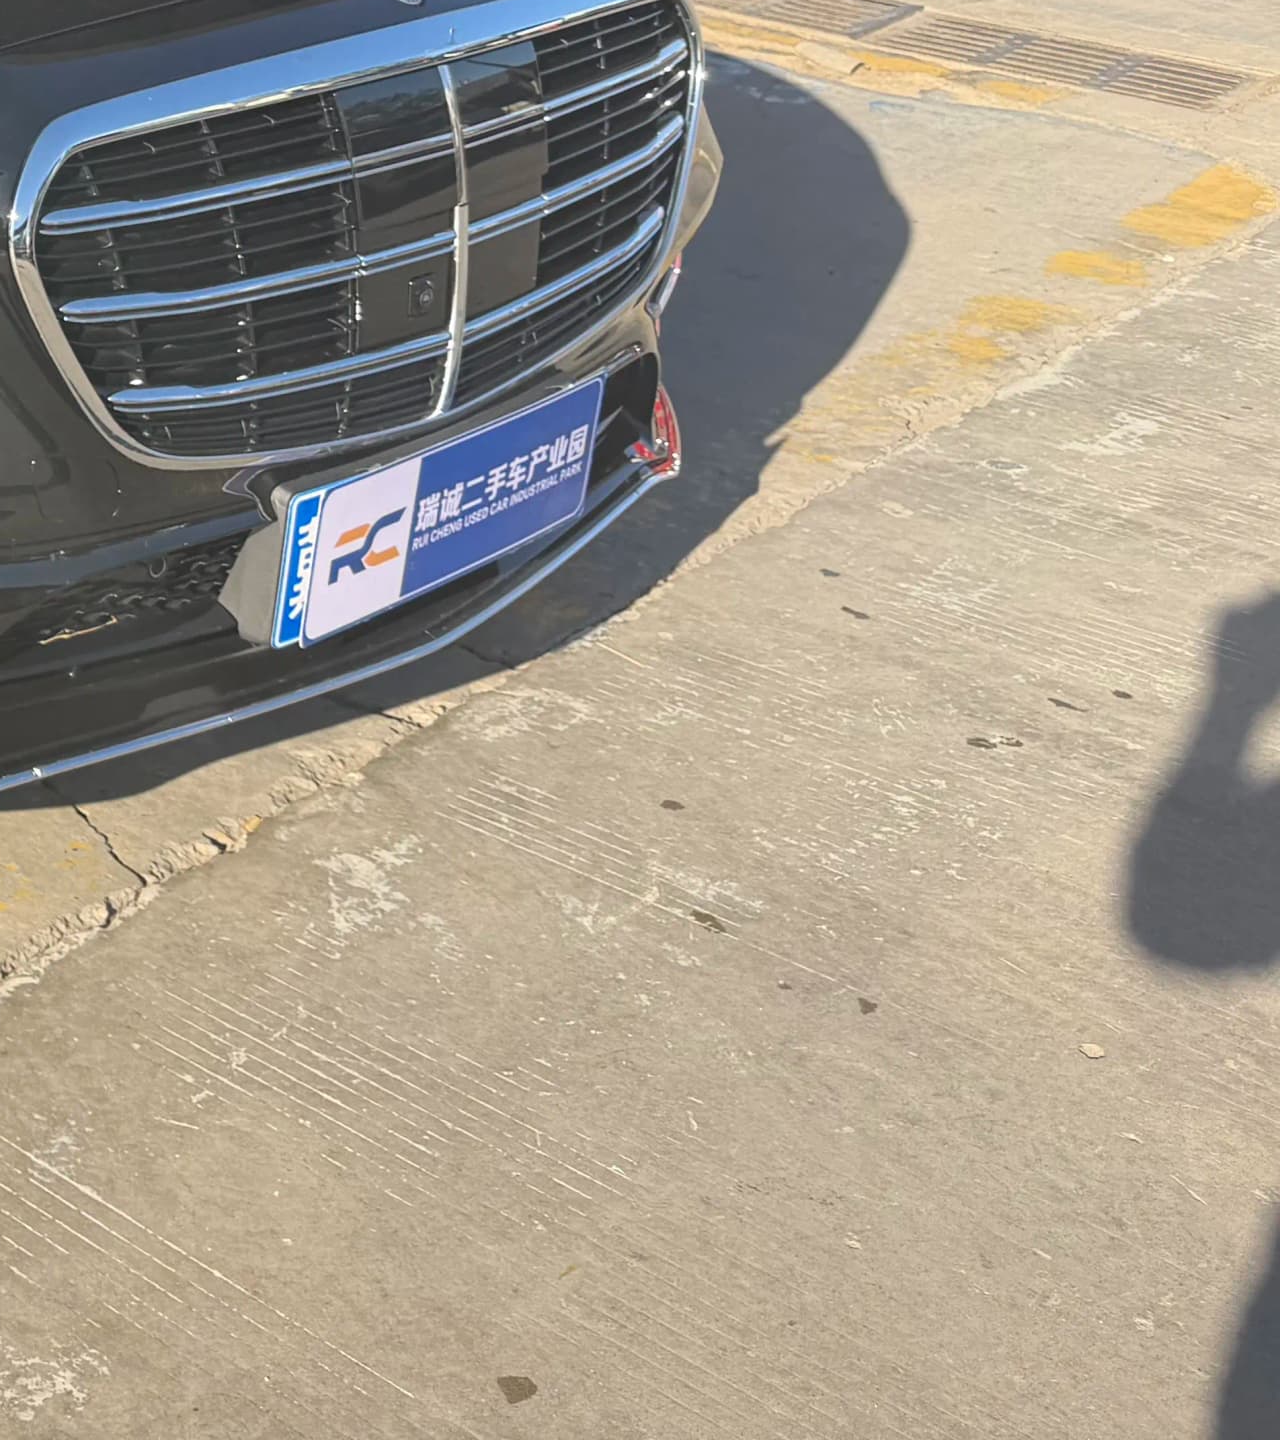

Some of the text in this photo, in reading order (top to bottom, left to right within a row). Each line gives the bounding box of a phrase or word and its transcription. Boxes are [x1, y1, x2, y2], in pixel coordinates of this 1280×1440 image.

[411, 461, 584, 552] RUI CHENG USED CAR INDUSTRIAL PARK
[413, 423, 590, 534] 瑞诚二手车产业园
